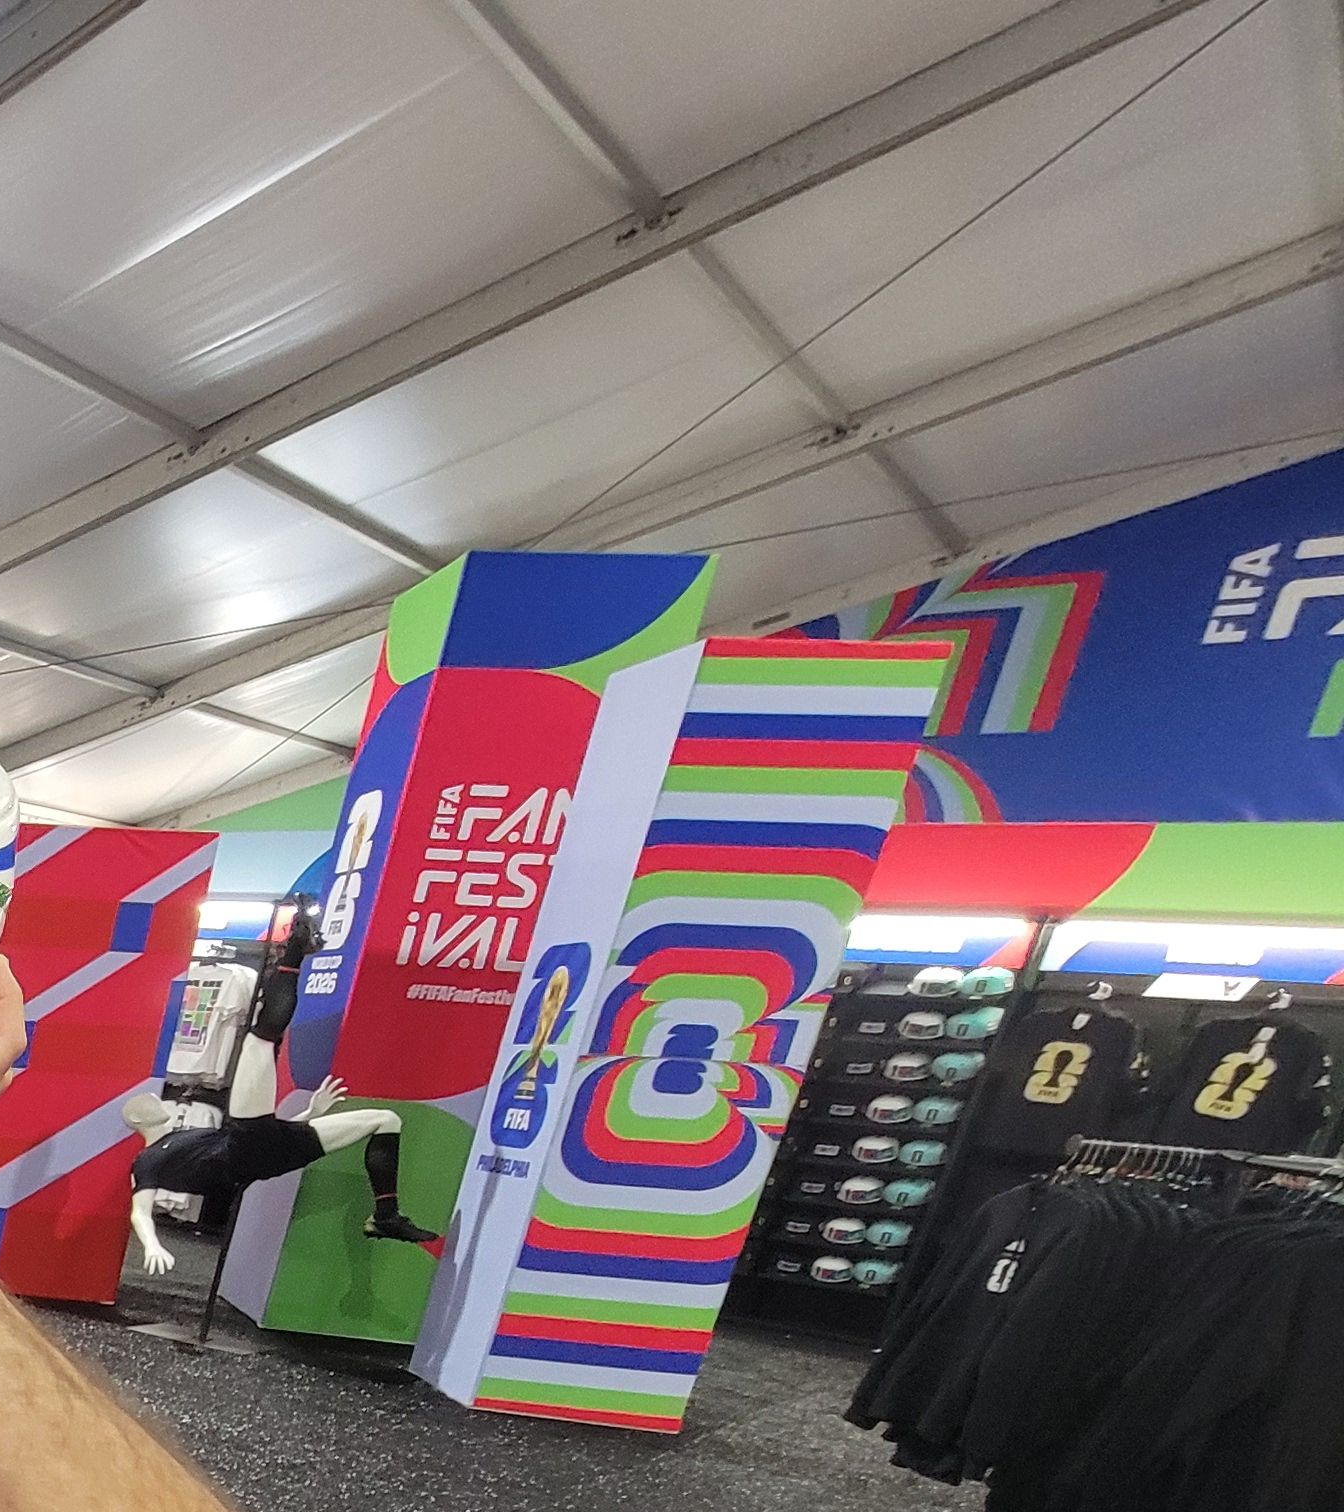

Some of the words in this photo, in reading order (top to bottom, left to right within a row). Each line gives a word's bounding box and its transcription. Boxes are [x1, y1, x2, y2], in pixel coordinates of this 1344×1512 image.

[1202, 543, 1282, 645] FIFA
[430, 784, 464, 840] FIFA
[413, 848, 557, 908] FES
[304, 972, 338, 994] 2026
[502, 1108, 531, 1132] FIFA
